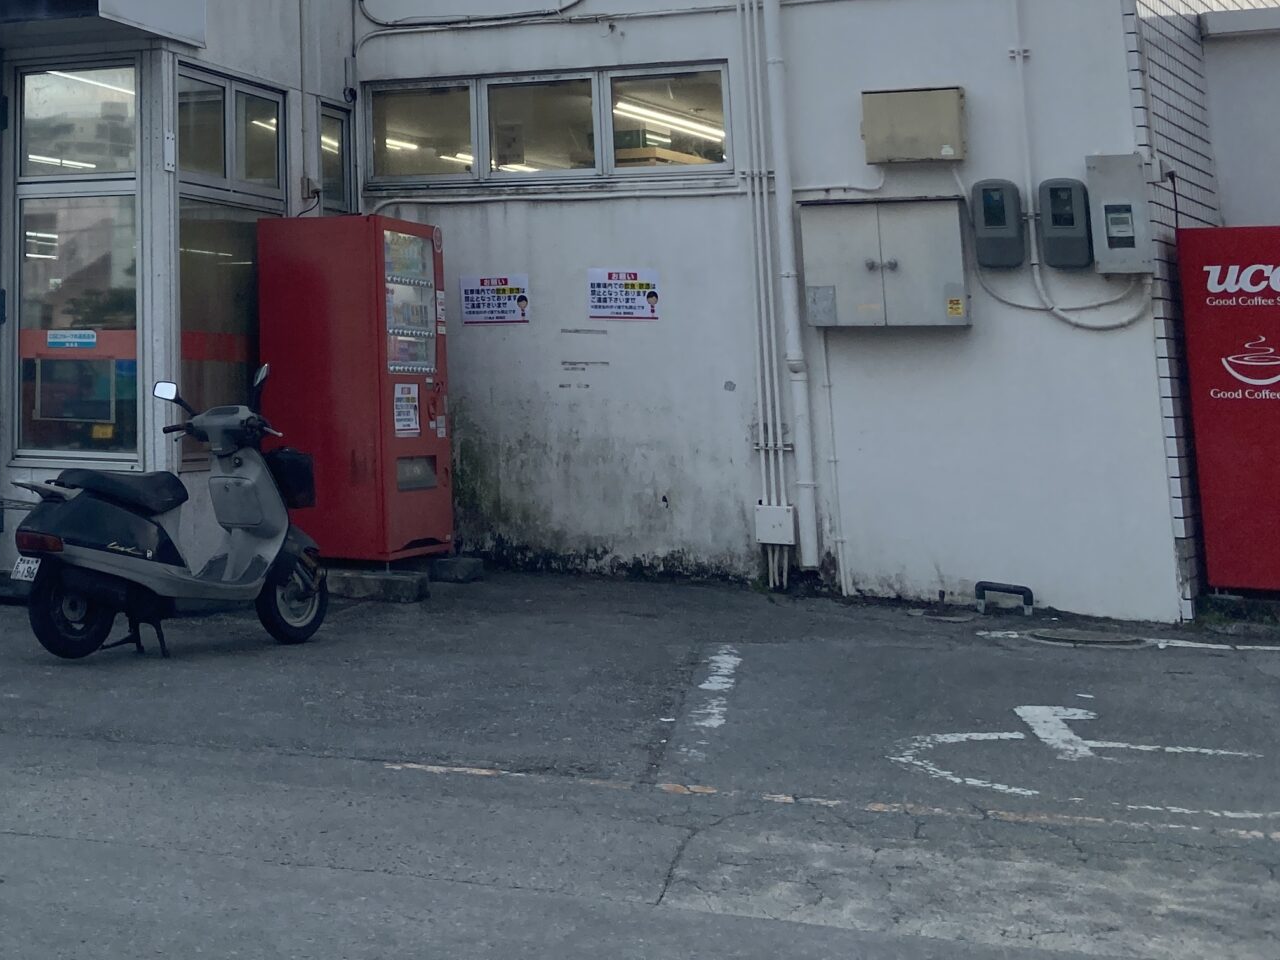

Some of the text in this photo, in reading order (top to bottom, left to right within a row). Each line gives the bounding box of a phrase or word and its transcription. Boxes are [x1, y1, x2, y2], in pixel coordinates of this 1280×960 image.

[1206, 296, 1236, 306] Good
[1238, 296, 1274, 306] Coffee
[1210, 388, 1242, 399] Good
